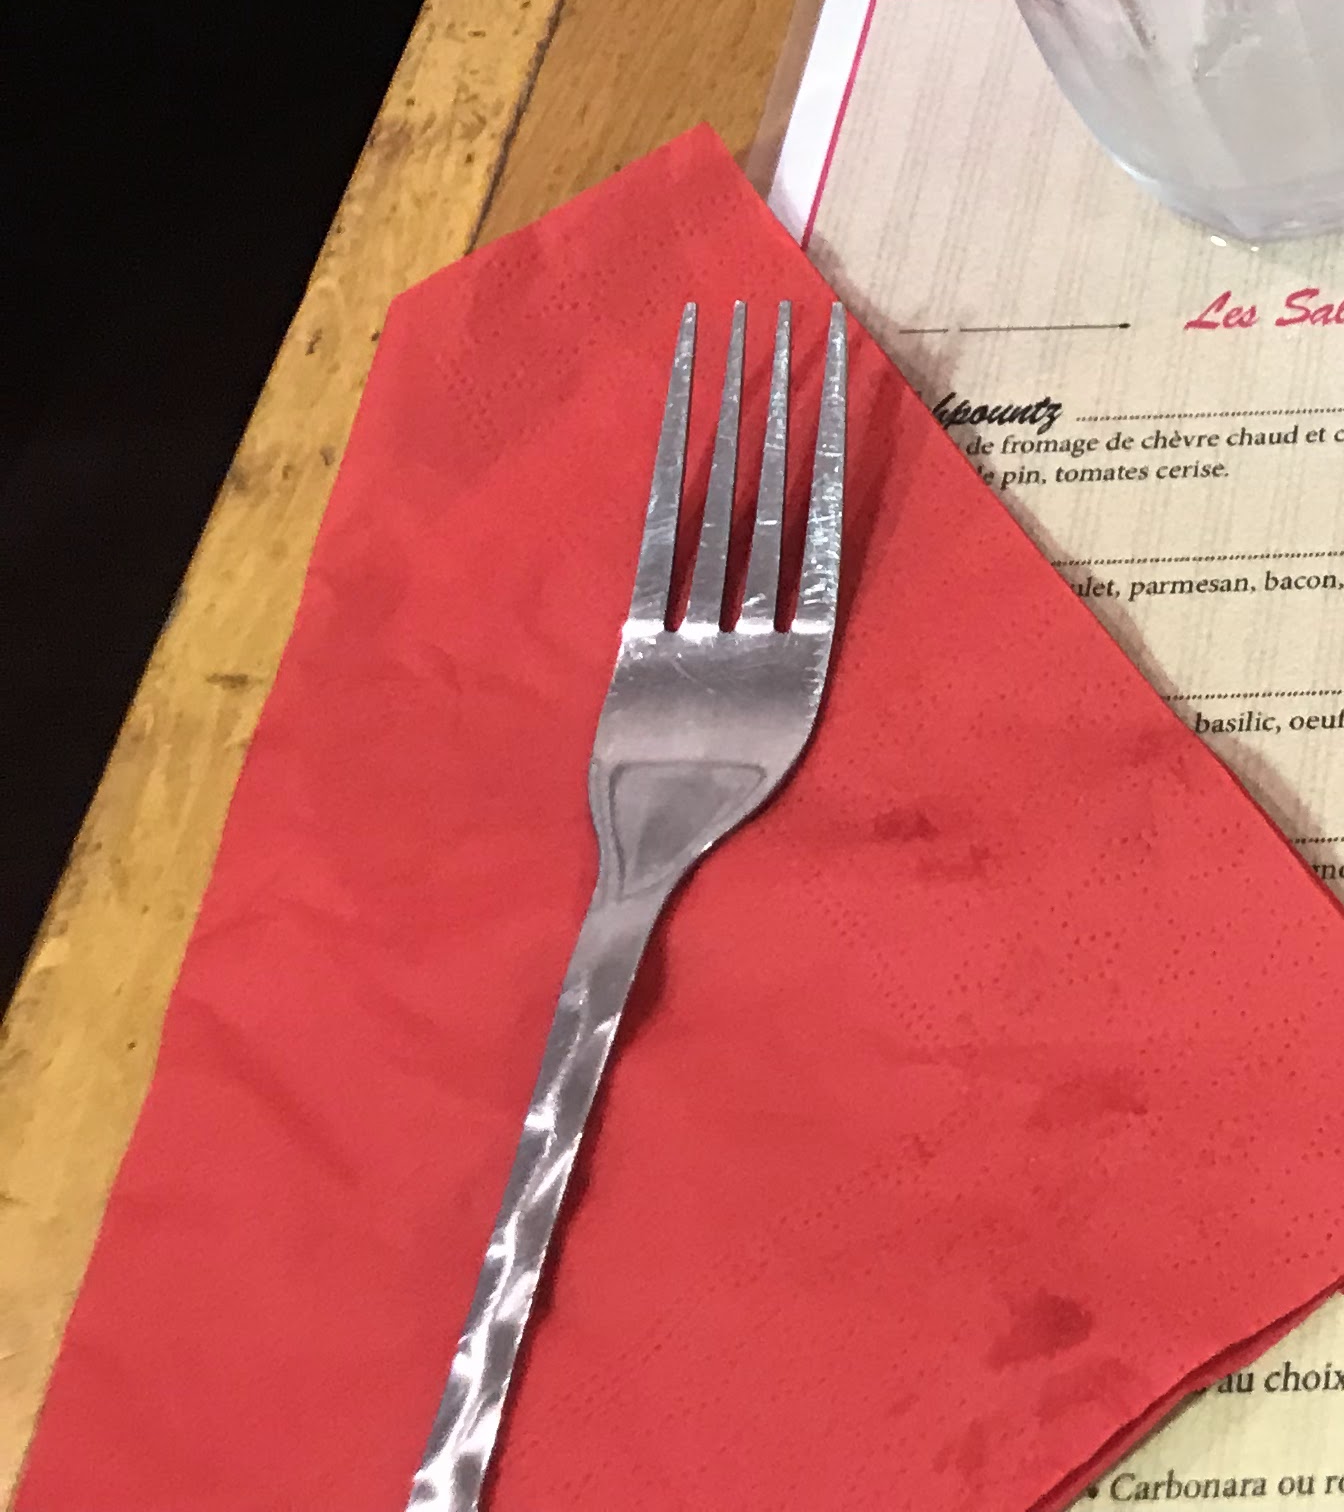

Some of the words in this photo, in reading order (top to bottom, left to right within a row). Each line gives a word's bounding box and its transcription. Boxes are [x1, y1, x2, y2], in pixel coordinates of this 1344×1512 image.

[1184, 291, 1257, 330] Les
[966, 436, 994, 455] de
[1001, 435, 1100, 458] fromage
[1106, 432, 1134, 451] de
[1141, 430, 1219, 449] chèvre
[1226, 425, 1298, 446] chaud
[1306, 428, 1326, 443] et
[1128, 578, 1256, 602] parmesan,
[1265, 571, 1344, 591] bacon,
